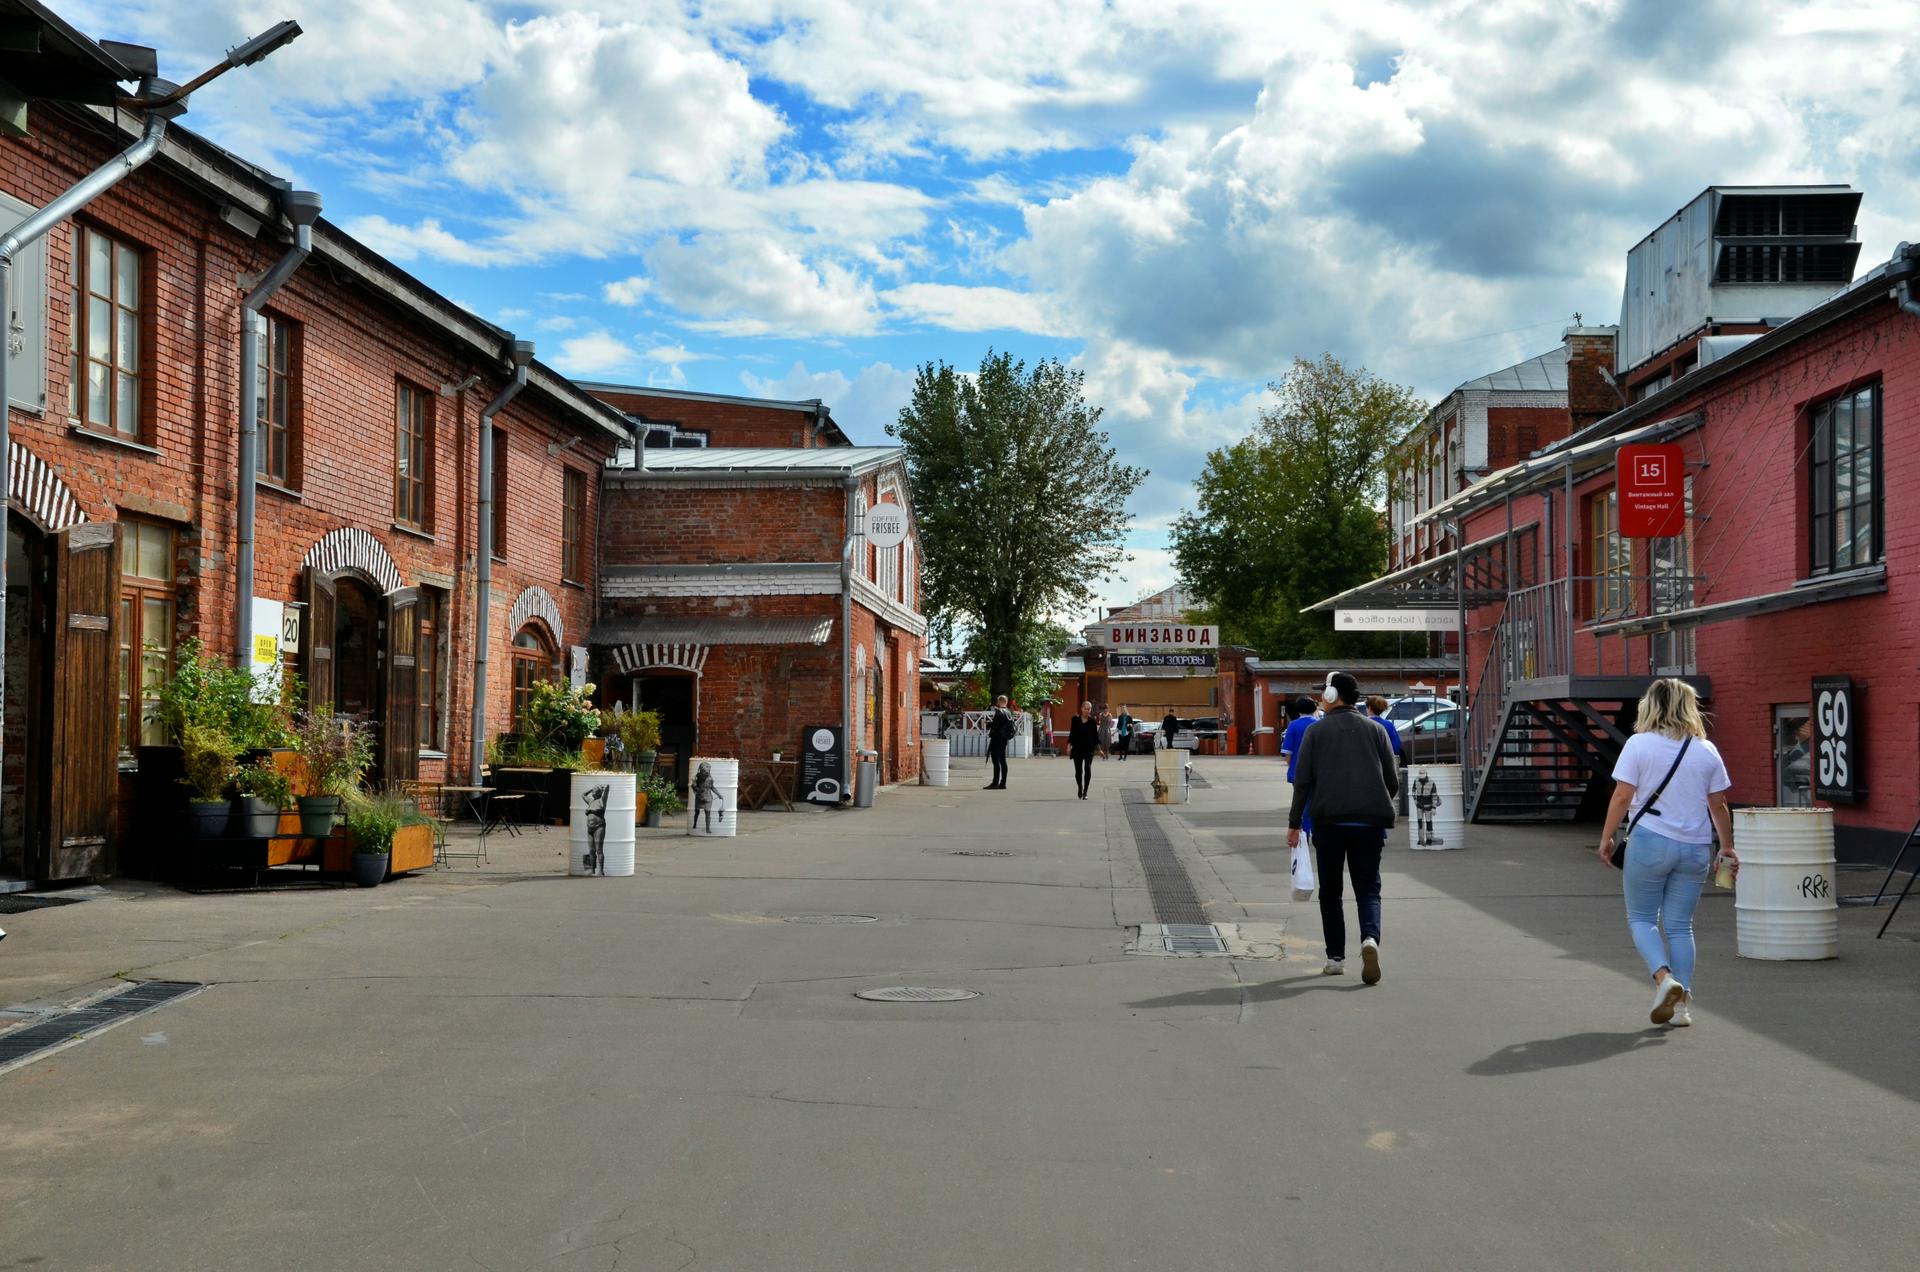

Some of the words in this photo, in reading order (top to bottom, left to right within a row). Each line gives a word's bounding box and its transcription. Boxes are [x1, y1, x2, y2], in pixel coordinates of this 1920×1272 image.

[1641, 463, 1660, 477] 15
[1634, 503, 1656, 511] Vintage
[871, 522, 901, 534] FRISBEE
[285, 618, 298, 643] 20
[1112, 628, 1211, 646] ВИНЗАВОД
[1117, 655, 1149, 665] ТЕПЕРЬ
[1151, 655, 1165, 665] ВЫ
[1166, 655, 1206, 665] ЗДОРОВЫ
[1817, 690, 1849, 738] GO
